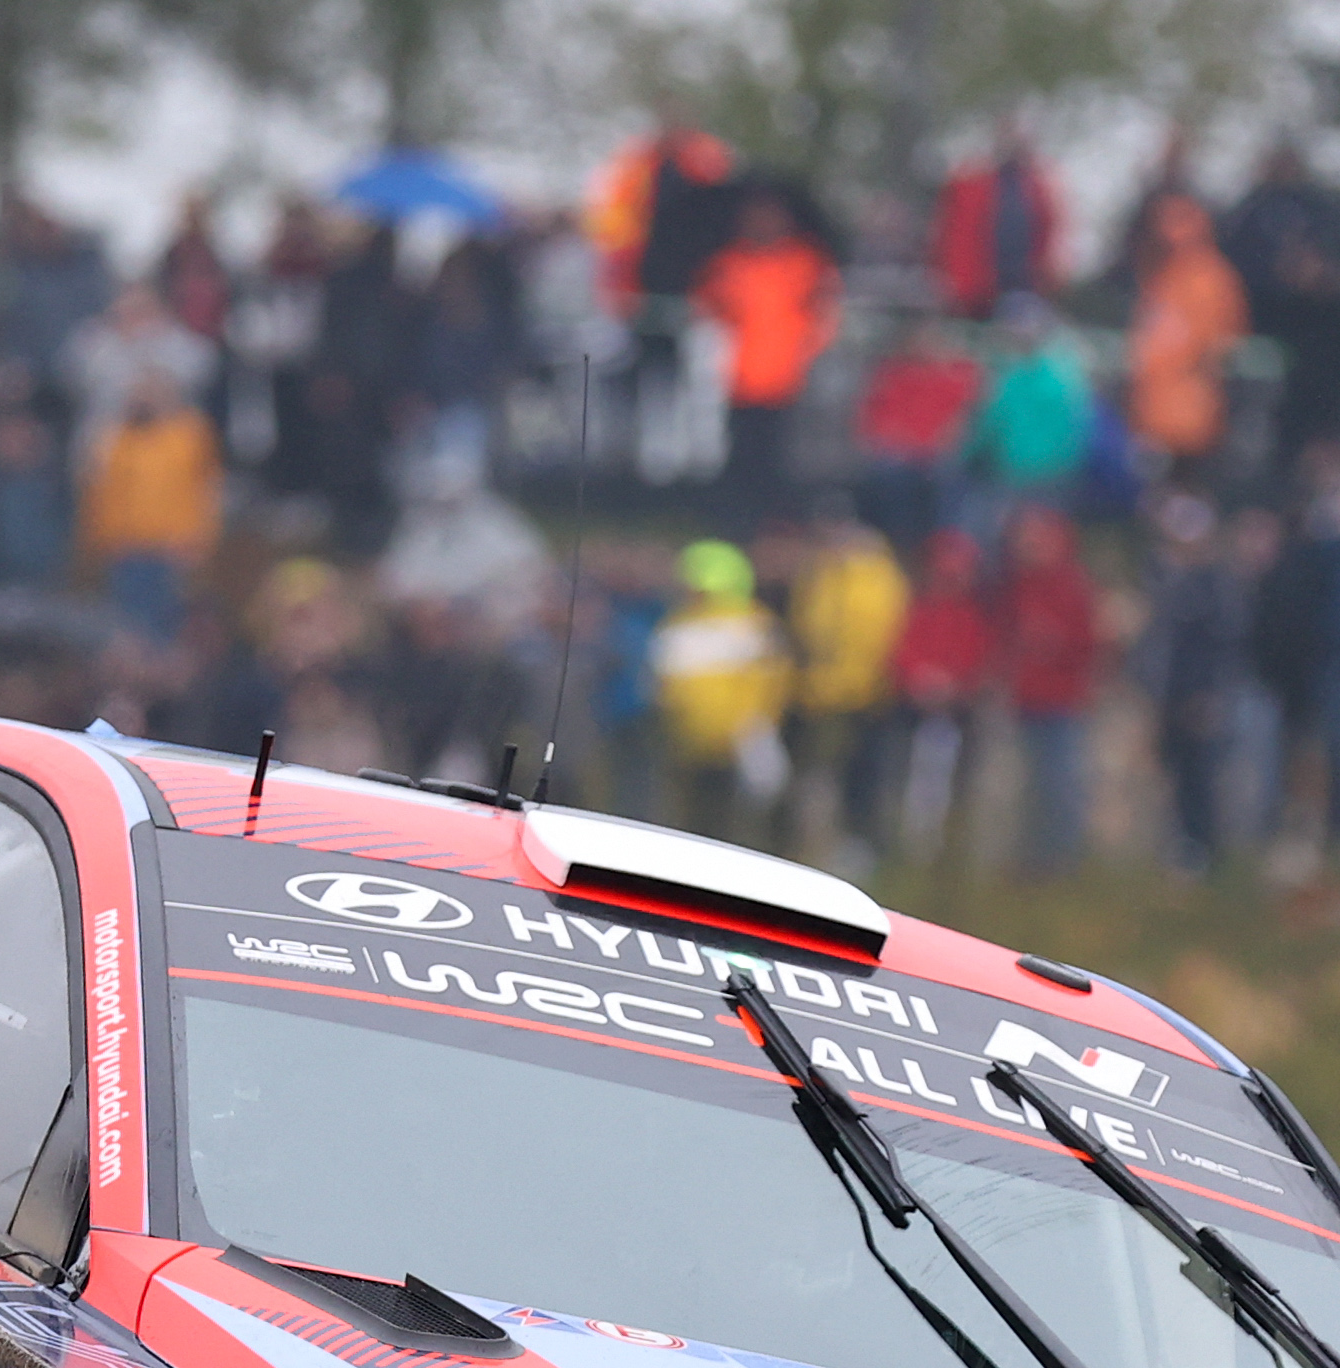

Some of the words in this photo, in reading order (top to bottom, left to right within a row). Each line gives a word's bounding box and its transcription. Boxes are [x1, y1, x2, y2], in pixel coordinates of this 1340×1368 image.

[227, 933, 353, 963] WRC
[502, 904, 940, 1035] HYUNDAI
[92, 907, 130, 1189] motorsport.hyundai.com
[383, 950, 715, 1048] WRC
[809, 1036, 958, 1106] ALL
